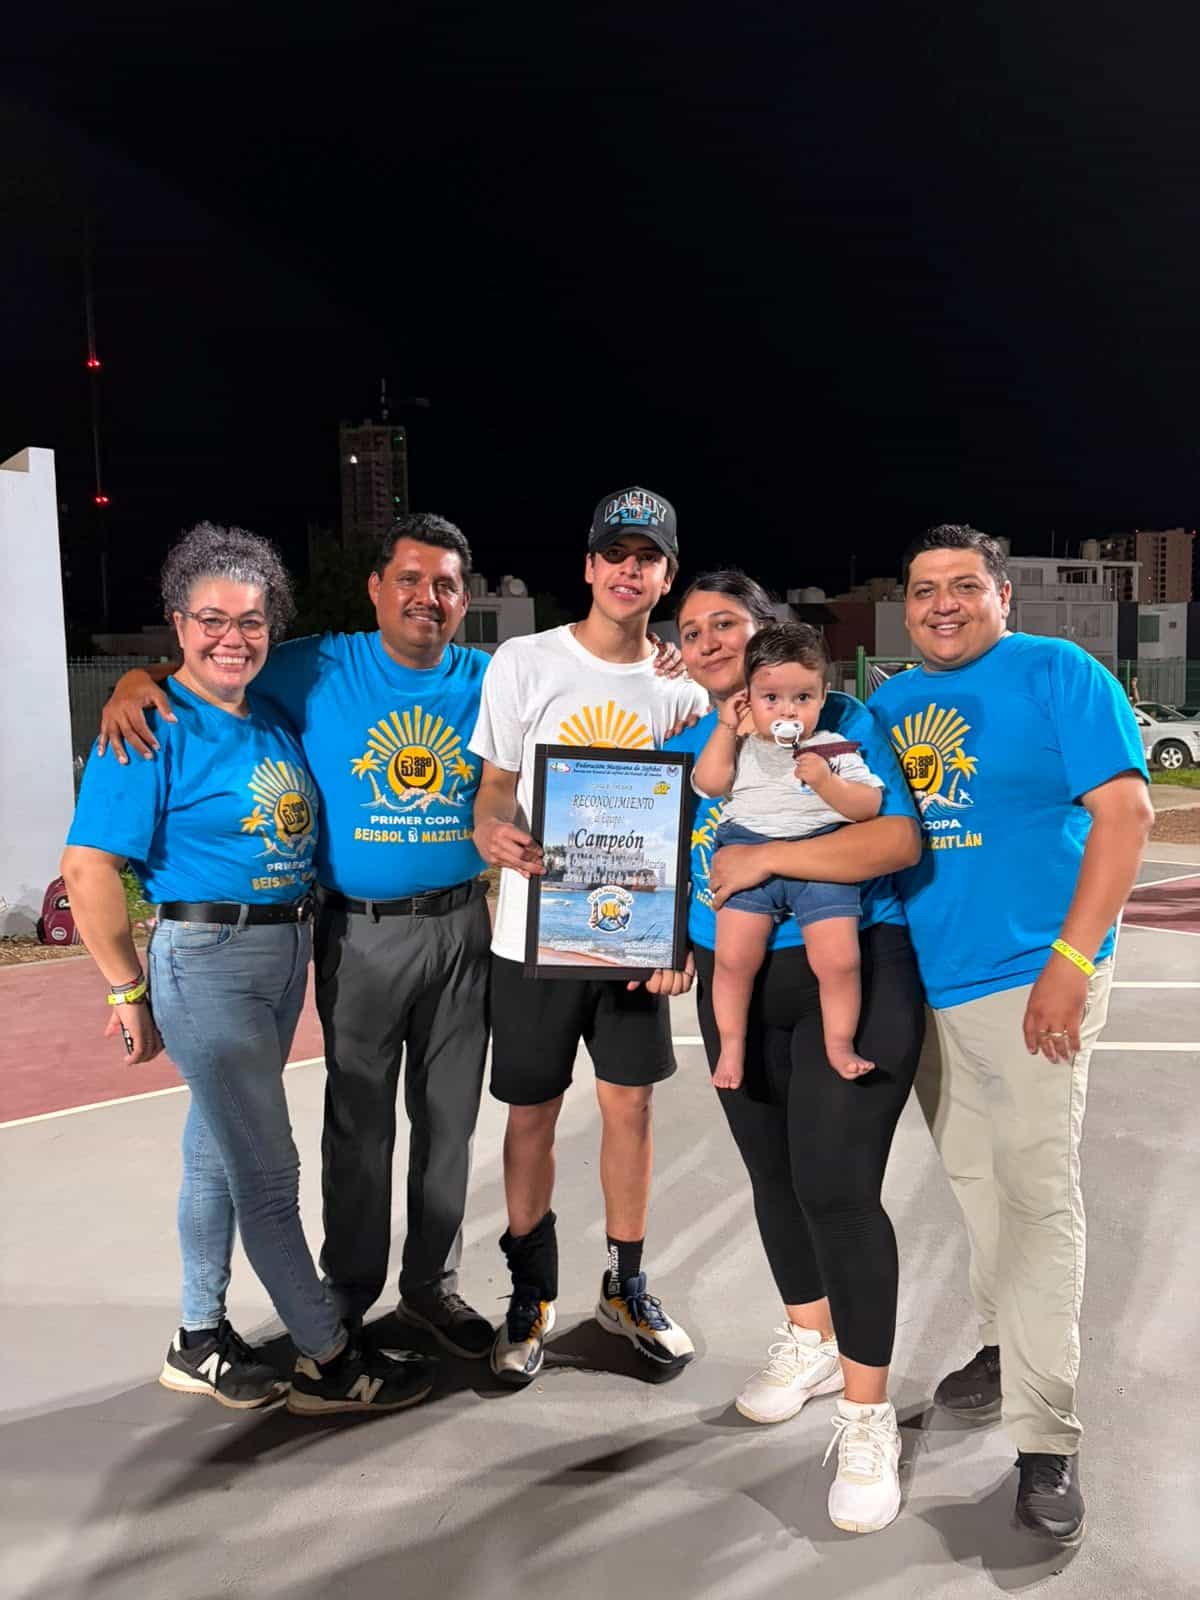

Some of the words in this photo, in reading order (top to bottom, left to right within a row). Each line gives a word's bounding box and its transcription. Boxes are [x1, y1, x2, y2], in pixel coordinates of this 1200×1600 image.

[573, 794, 655, 810] RECONOCIMIENTO
[370, 815, 422, 825] PRIMER
[424, 815, 460, 825] COPA
[922, 819, 962, 830] COPA
[354, 827, 405, 842] BEISBOL
[575, 829, 644, 854] Campeón
[931, 831, 982, 849] ZATLÁN
[346, 1374, 385, 1404] N
